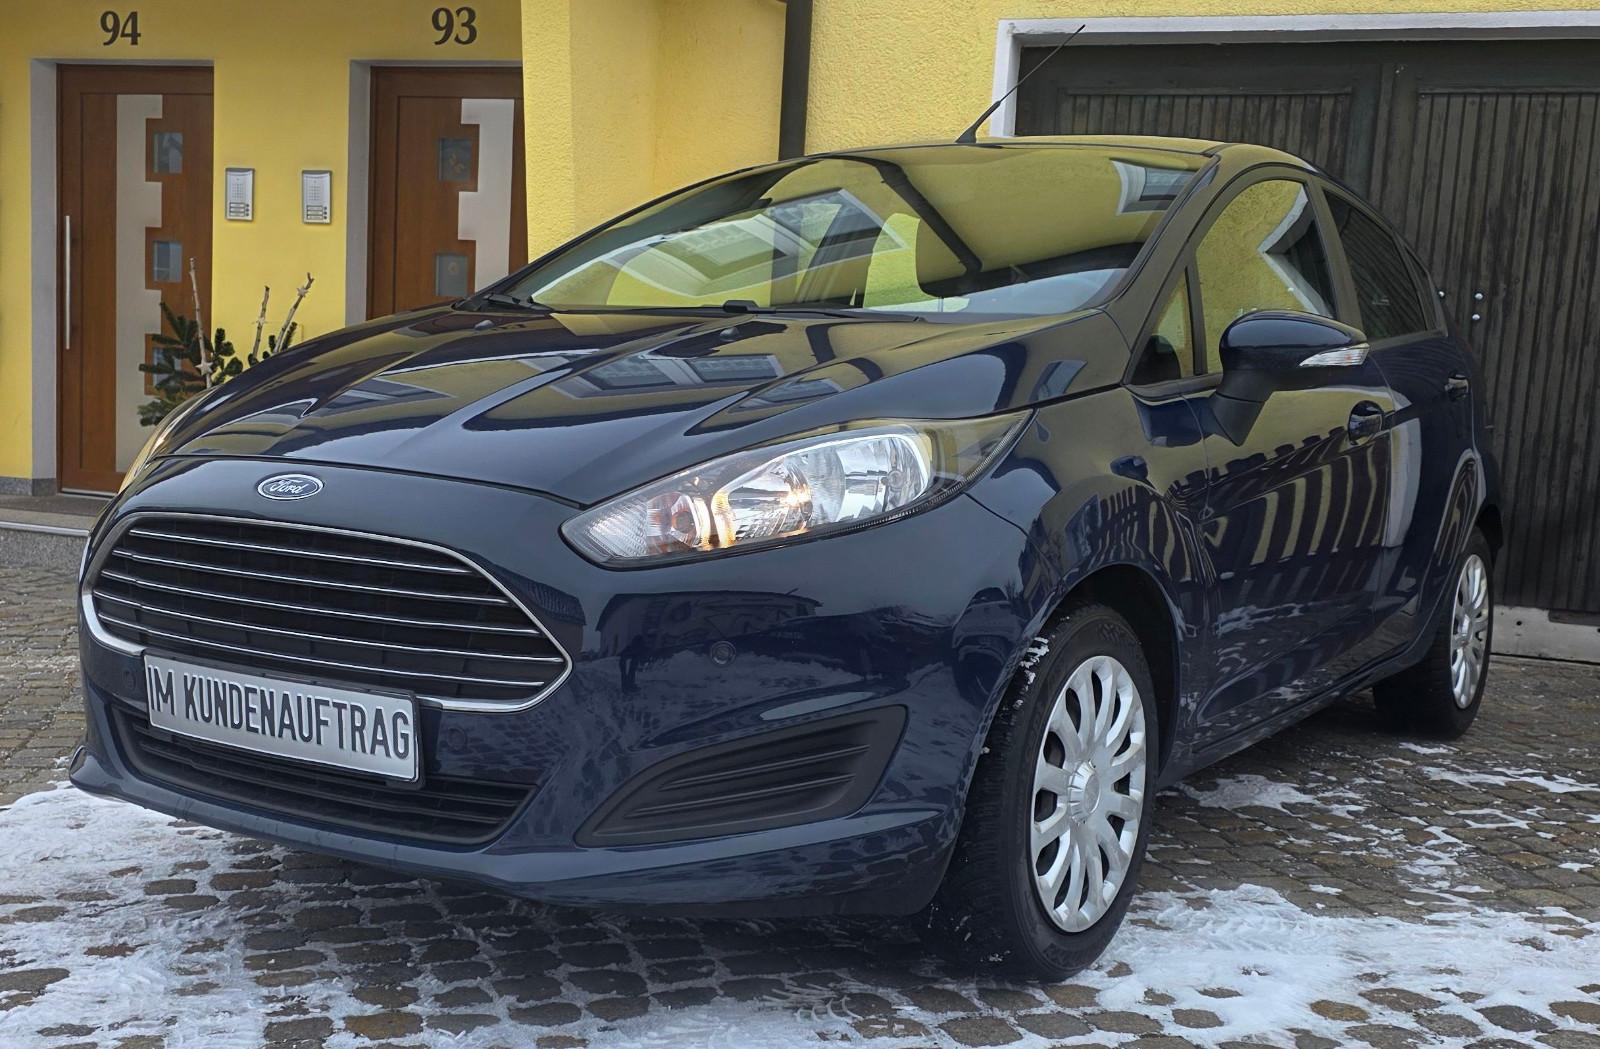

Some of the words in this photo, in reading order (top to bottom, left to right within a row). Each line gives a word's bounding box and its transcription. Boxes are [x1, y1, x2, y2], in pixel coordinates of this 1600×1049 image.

[100, 10, 141, 46] 94
[431, 6, 477, 45] 93
[147, 665, 176, 717] IM
[183, 673, 411, 760] KUNDENAUFTRAG
